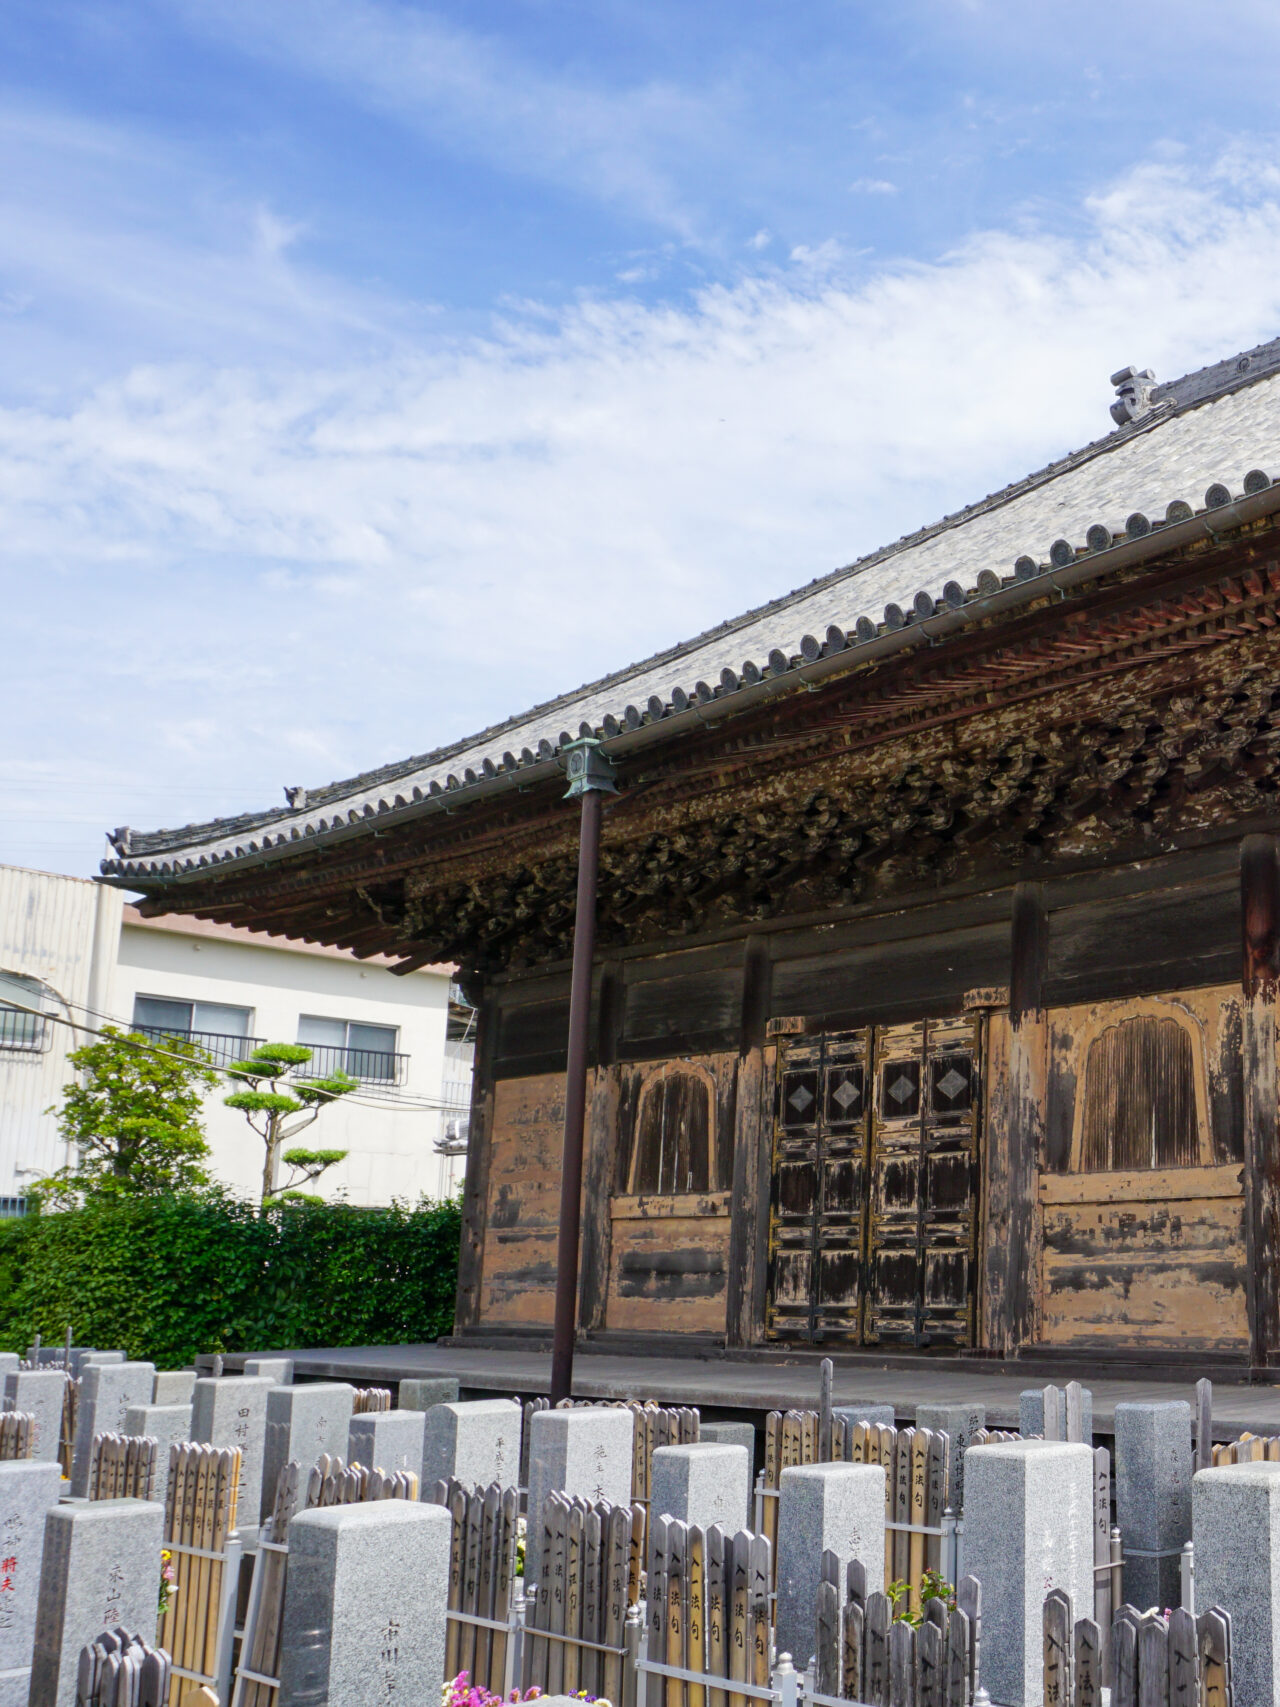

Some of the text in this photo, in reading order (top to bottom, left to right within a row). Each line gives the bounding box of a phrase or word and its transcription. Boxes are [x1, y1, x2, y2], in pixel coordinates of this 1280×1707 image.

[767, 1430, 775, 1482] 入一法句
[914, 1449, 925, 1508] 入一法句
[1099, 1471, 1107, 1534] 入一法句
[555, 1531, 564, 1604] 入一法句
[653, 1550, 663, 1632] 入一法句
[671, 1552, 681, 1634] 入一法句
[691, 1558, 700, 1641] 入一法句
[710, 1556, 720, 1643] 入一法句
[735, 1564, 746, 1648] 入一法句
[754, 1569, 766, 1656] 入一法句
